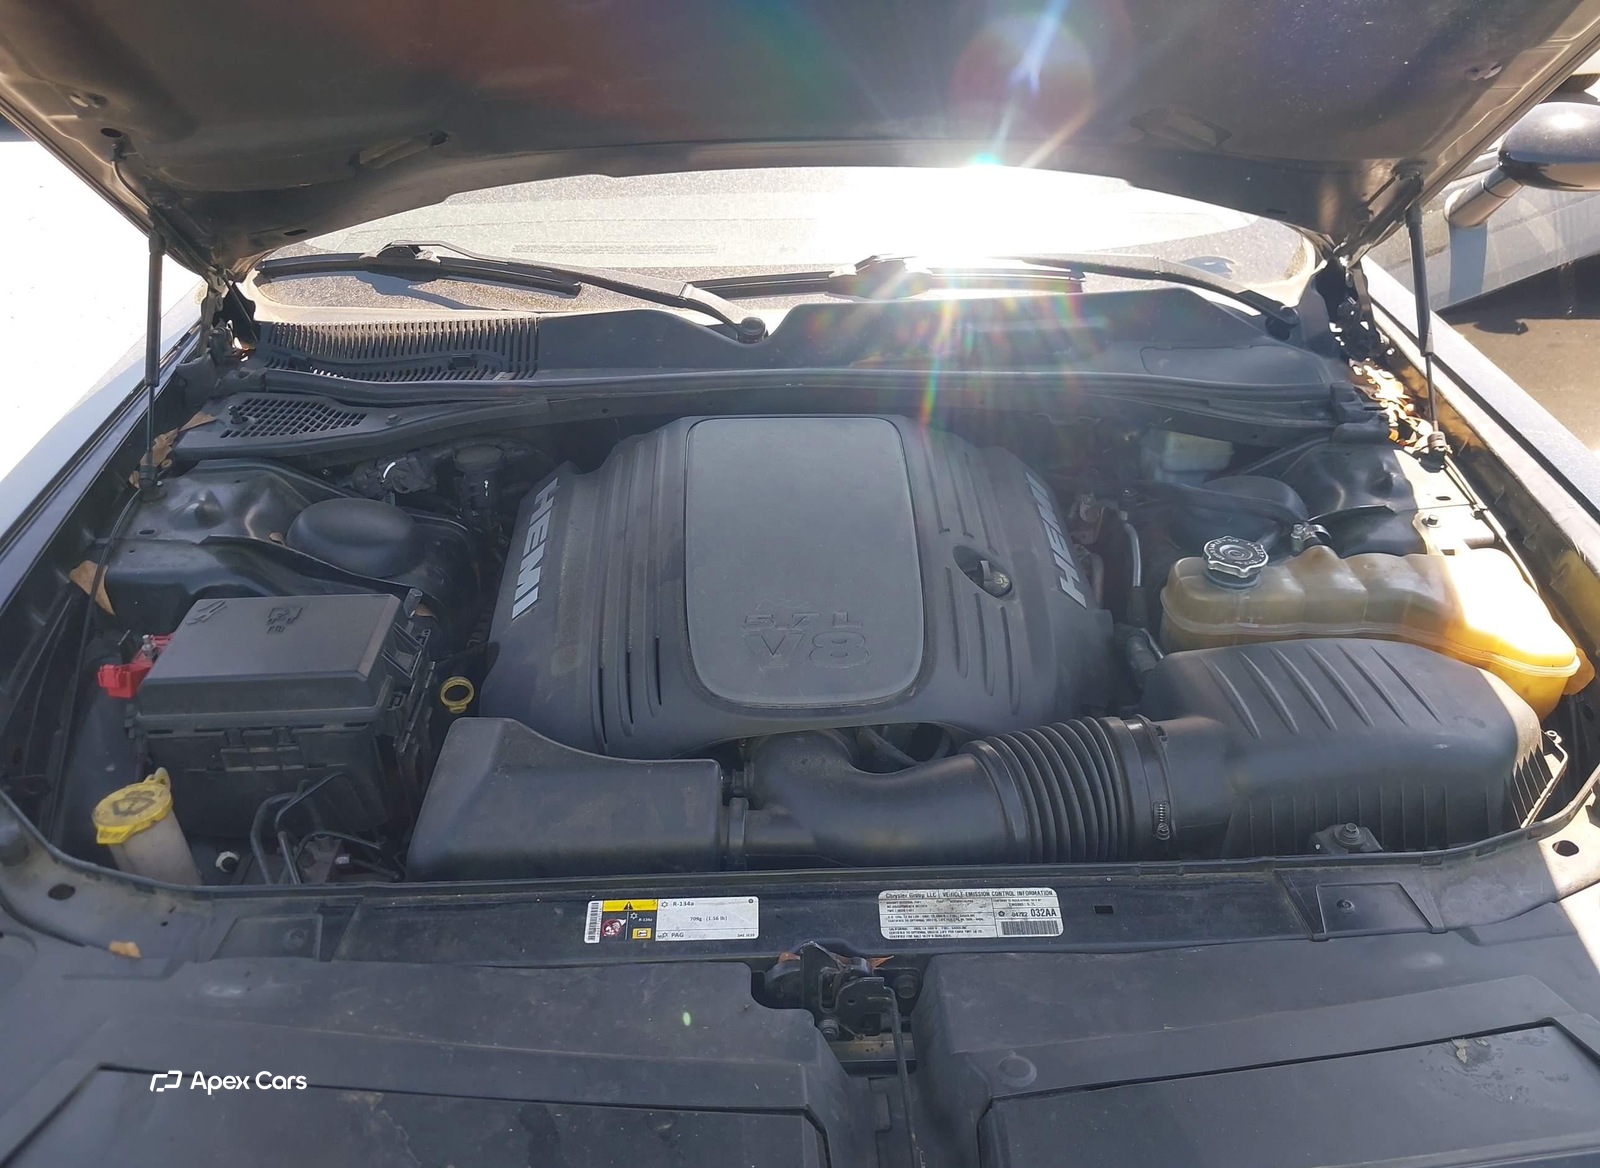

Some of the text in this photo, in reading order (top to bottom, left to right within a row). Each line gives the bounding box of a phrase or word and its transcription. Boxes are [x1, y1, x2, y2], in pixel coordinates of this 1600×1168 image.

[511, 477, 560, 620] HEMI
[1026, 472, 1087, 608] HEMI
[743, 631, 870, 669] V8
[1031, 908, 1057, 917] 032AA
